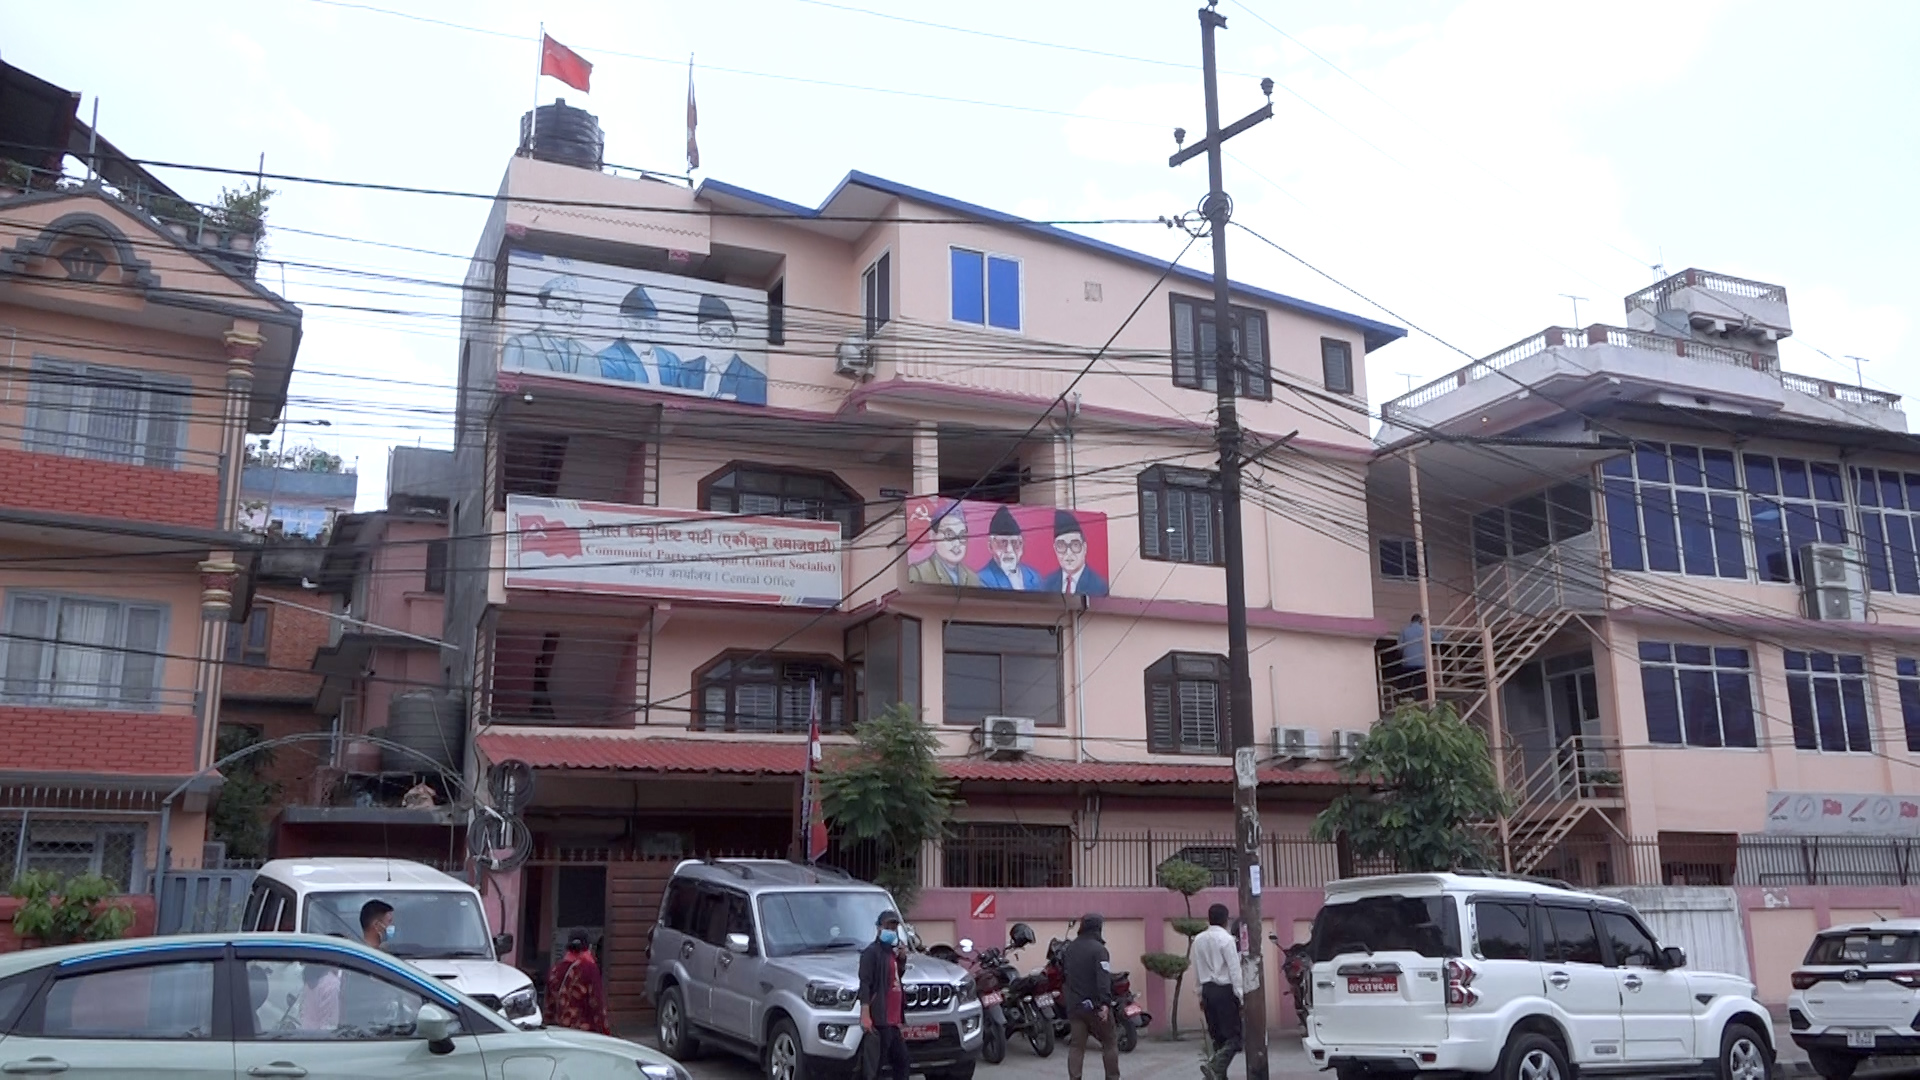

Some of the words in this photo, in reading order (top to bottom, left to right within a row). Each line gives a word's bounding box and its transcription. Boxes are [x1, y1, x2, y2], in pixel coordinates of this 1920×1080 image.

[585, 544, 653, 559] Communist
[657, 548, 687, 563] Party
[742, 557, 785, 569] (Unified
[789, 559, 837, 574] Socialist)
[721, 571, 760, 584] Central
[763, 573, 796, 588] Office
